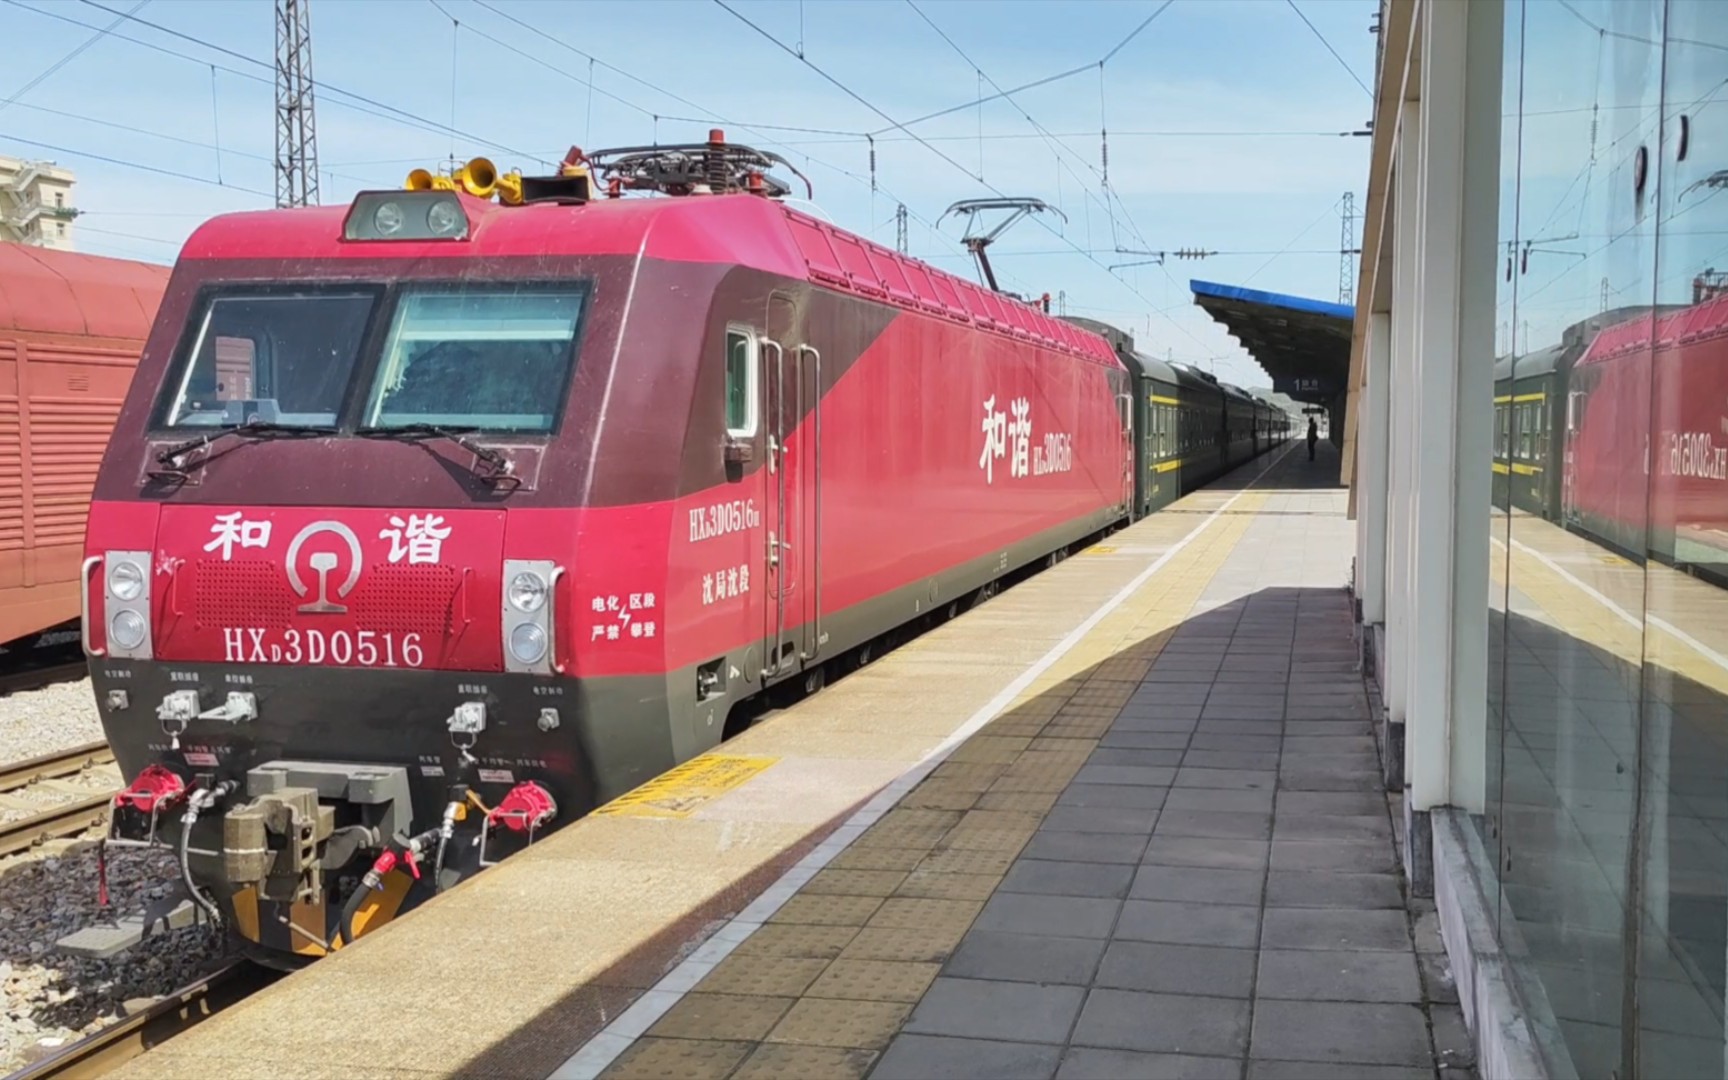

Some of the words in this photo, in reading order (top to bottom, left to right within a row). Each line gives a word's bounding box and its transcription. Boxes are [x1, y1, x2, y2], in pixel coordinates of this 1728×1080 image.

[979, 393, 1032, 485] 和谐
[203, 511, 272, 561] 和
[379, 513, 452, 565] 谐
[702, 564, 749, 605] 沈局沈段
[223, 627, 424, 667] HXD3D0516
